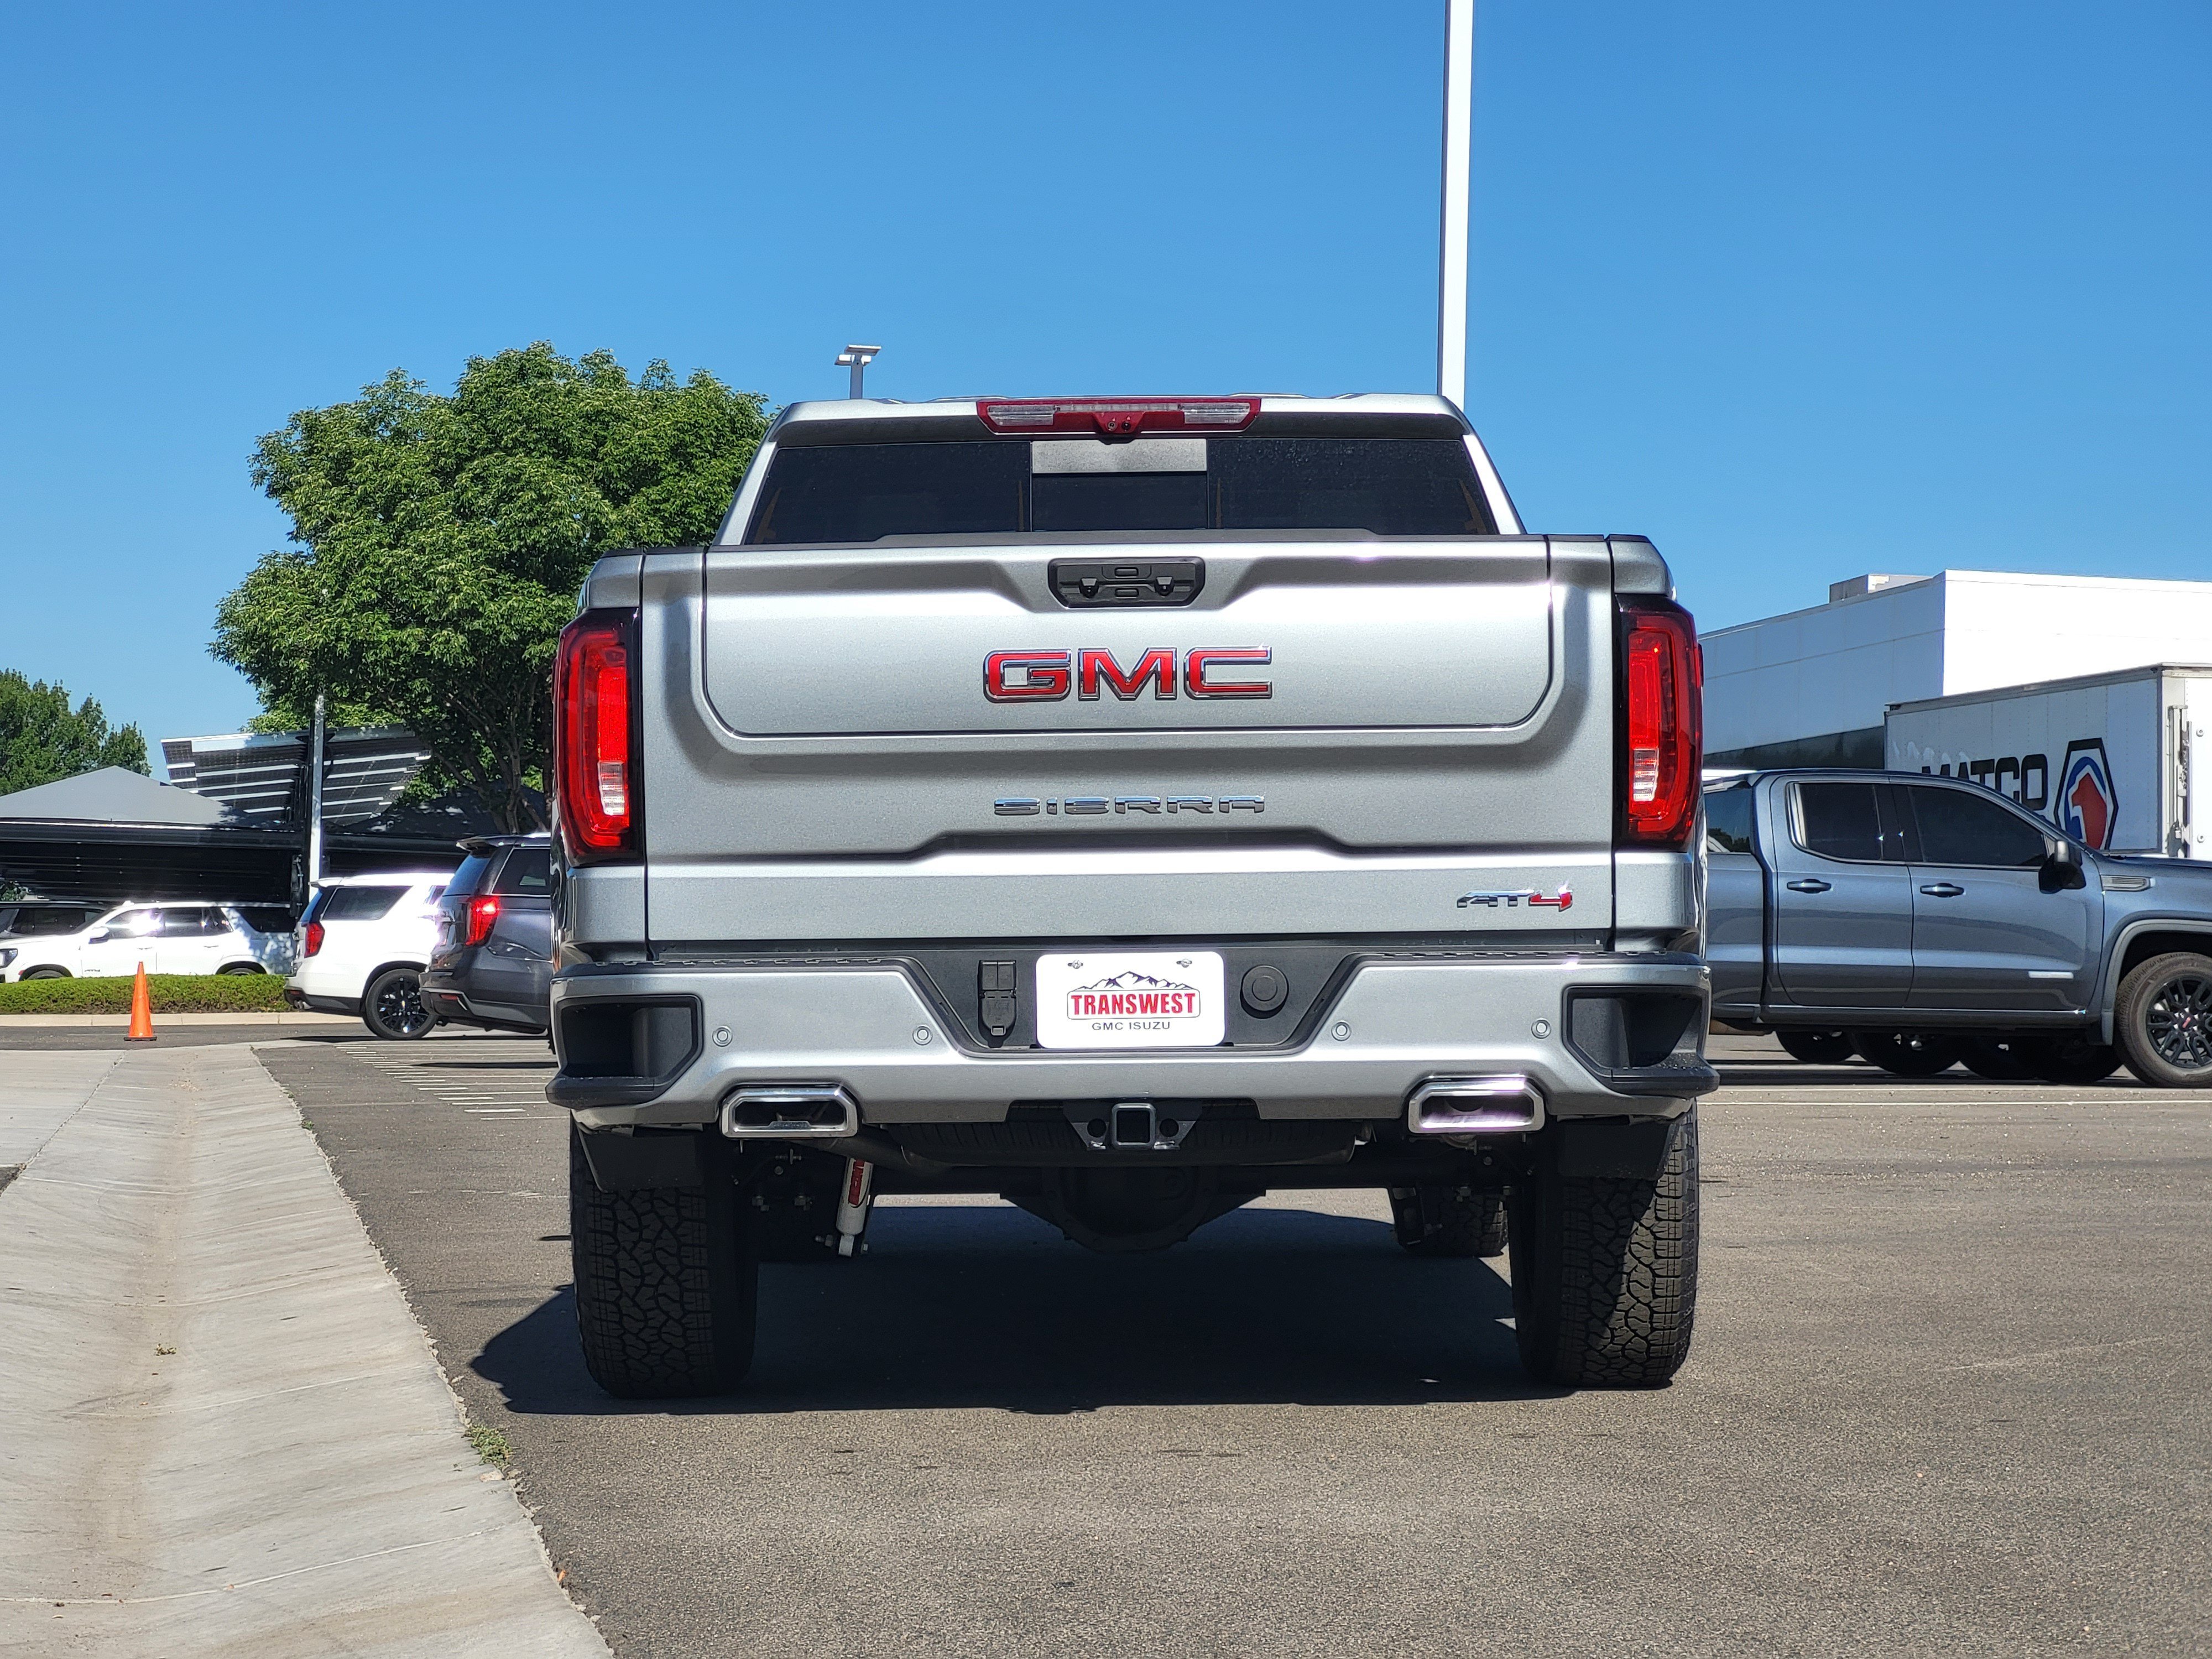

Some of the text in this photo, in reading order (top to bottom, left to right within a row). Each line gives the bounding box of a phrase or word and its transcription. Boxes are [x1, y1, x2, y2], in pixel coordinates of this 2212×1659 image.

[983, 646, 1272, 703] GMC
[1921, 753, 2048, 811] TCO
[994, 795, 1265, 815] SIERRA
[1457, 889, 1573, 912] AT4
[1071, 993, 1196, 1015] TRANSWEST
[1092, 1021, 1171, 1031] GMC ISUZU
